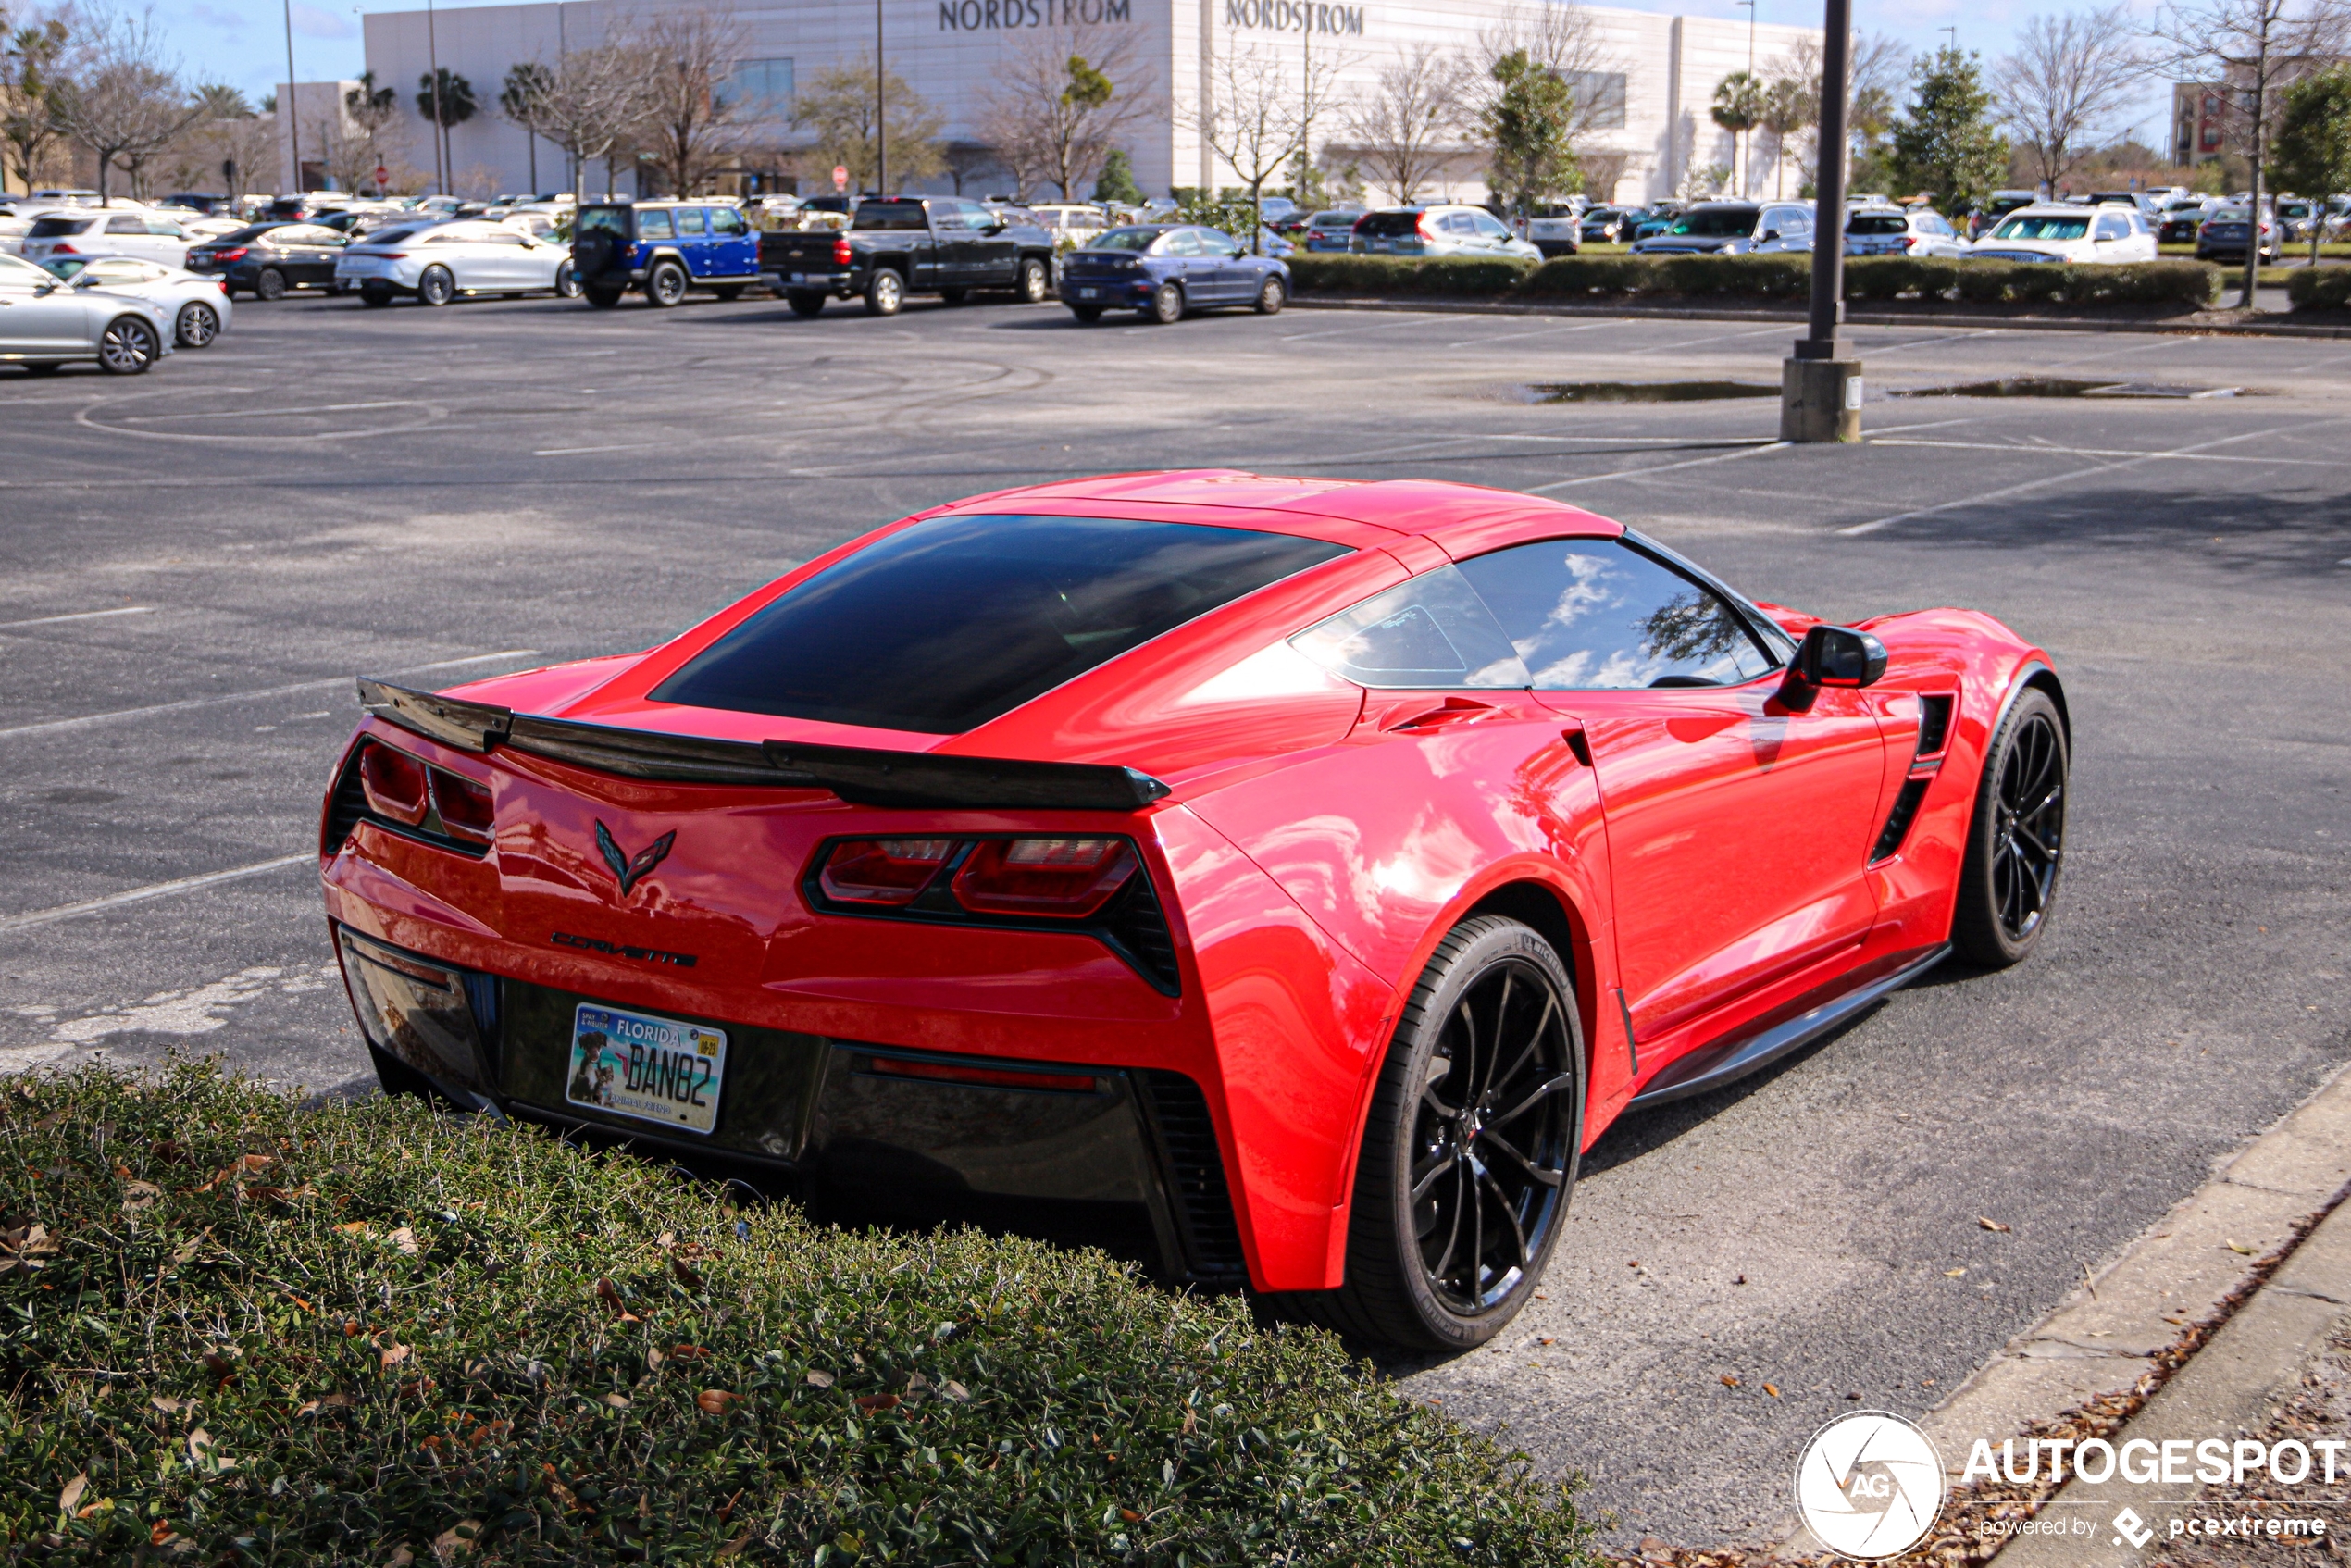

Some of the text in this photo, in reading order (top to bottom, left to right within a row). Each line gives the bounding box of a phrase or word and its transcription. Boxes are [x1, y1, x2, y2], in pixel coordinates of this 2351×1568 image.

[939, 0, 1131, 31] NORDSTROM
[1226, 0, 1364, 36] NORDSTROM
[550, 931, 698, 967] CORVETTE
[1533, 940, 1569, 989] MICHELIN
[581, 1012, 596, 1020] SPAY
[616, 1019, 681, 1047] FLORIDA
[626, 1042, 712, 1107] BAN82
[611, 1094, 671, 1114] ANIMAL FRIEND
